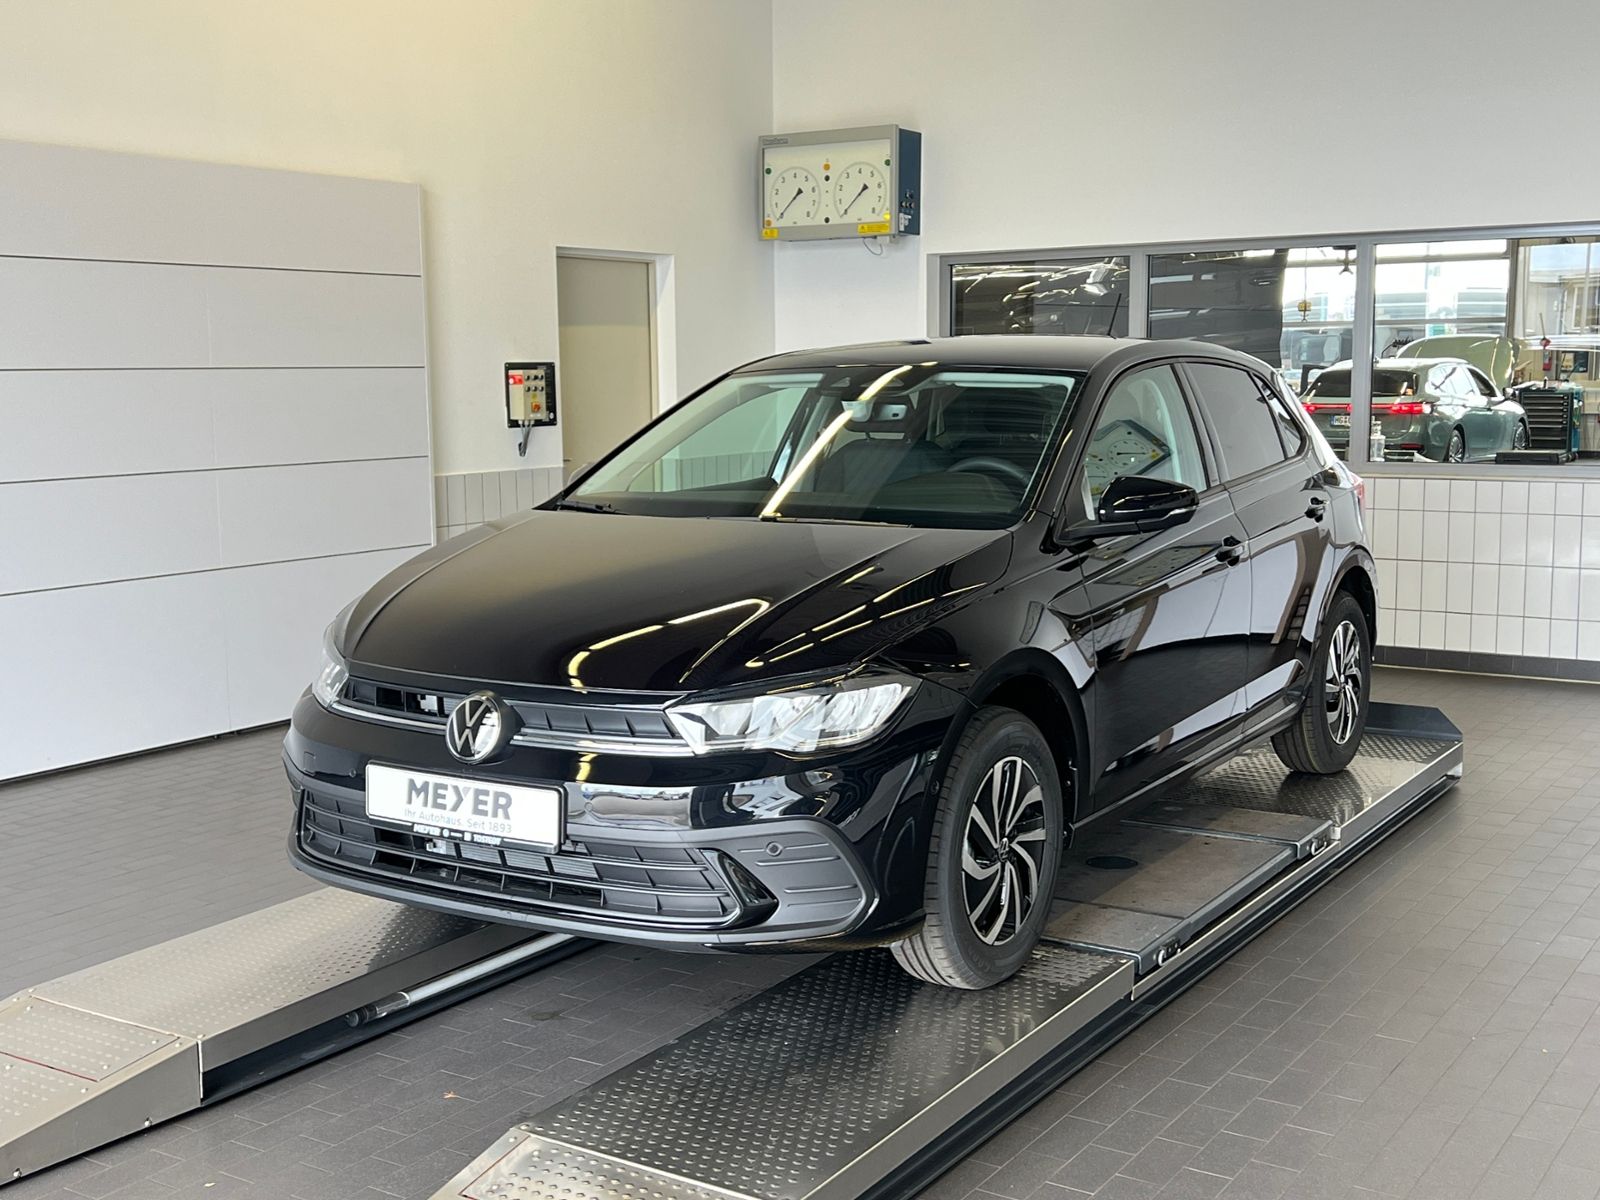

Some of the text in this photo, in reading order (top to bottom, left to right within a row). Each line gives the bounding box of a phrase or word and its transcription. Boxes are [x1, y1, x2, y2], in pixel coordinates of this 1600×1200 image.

[406, 777, 513, 820] MEYER
[404, 808, 416, 817] Ihr
[467, 818, 486, 830] Seit
[489, 821, 512, 833] 1893
